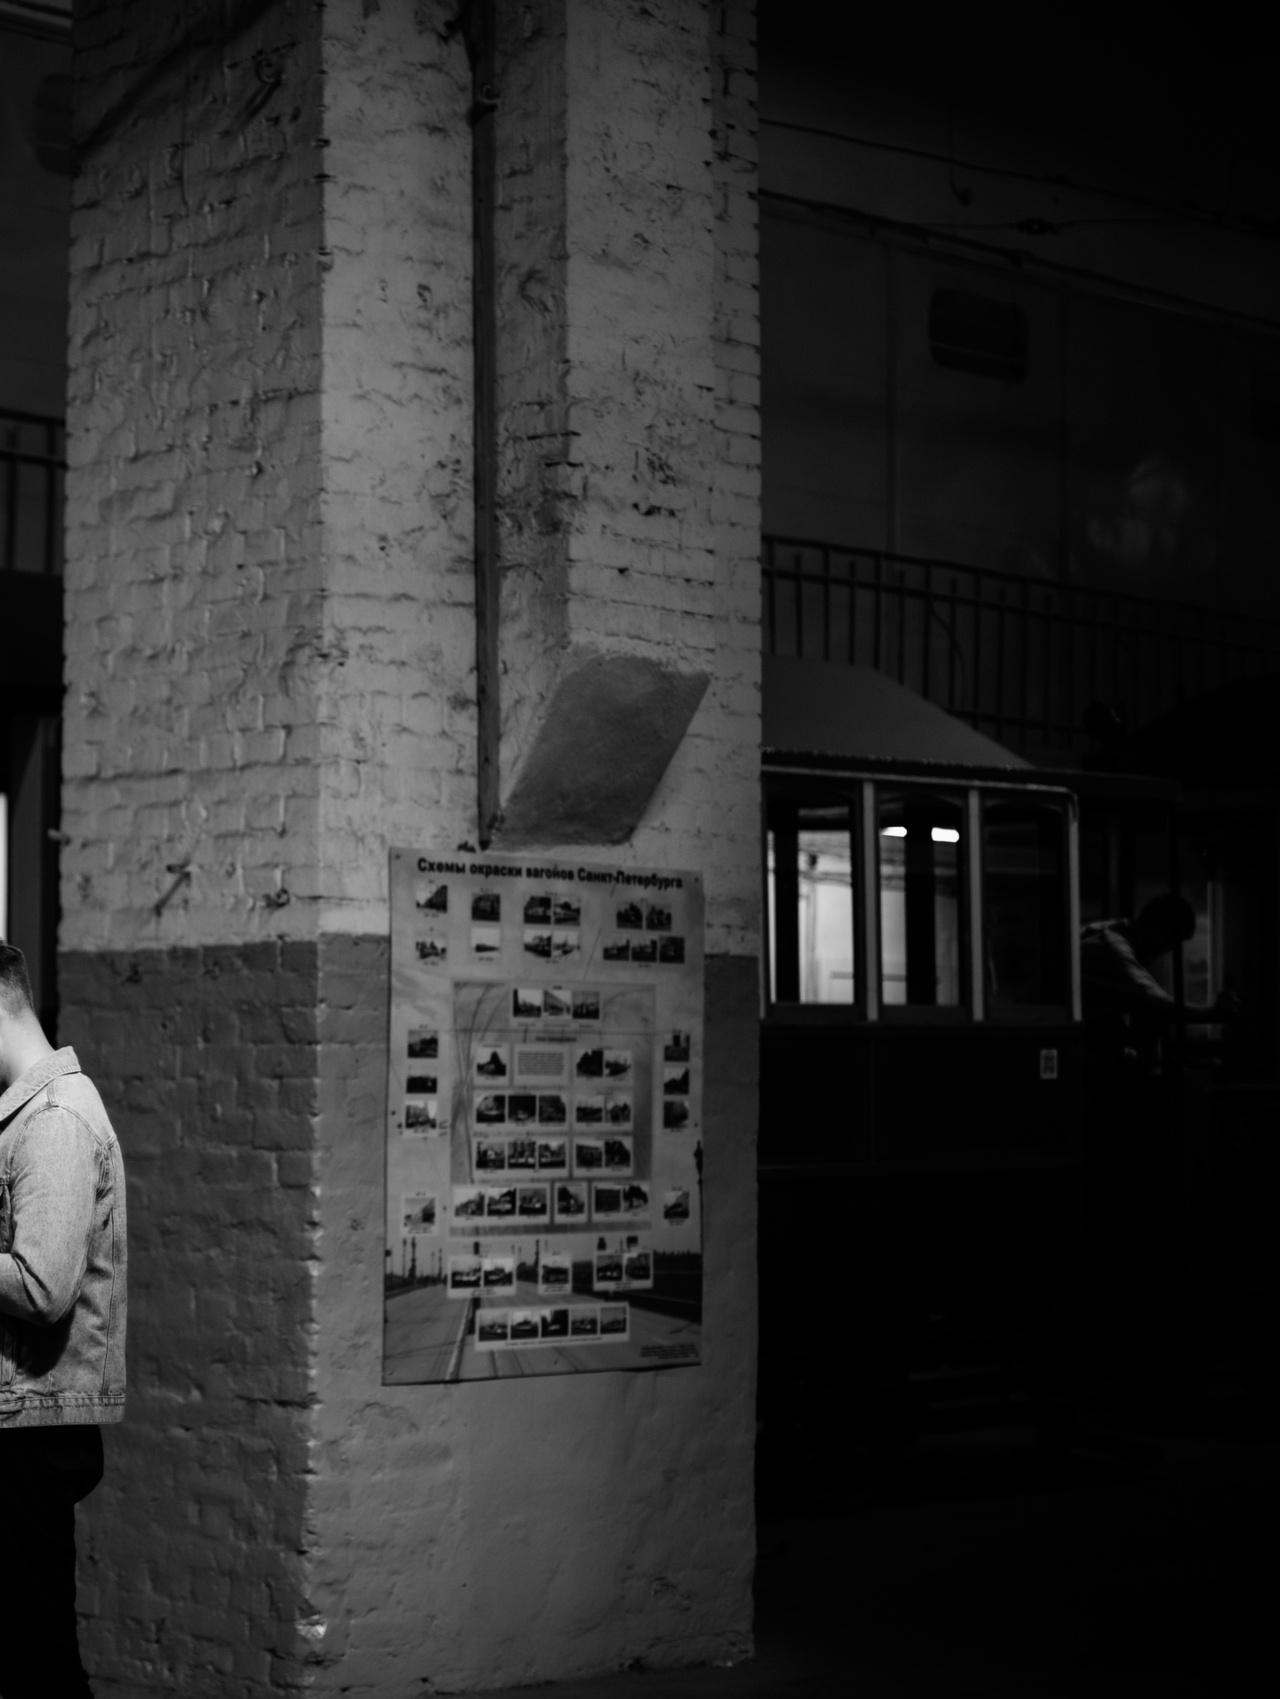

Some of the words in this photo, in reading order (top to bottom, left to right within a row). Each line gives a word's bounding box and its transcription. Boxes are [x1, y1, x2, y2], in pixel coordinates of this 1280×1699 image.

[417, 857, 466, 874] Схемы
[470, 863, 523, 879] окраски
[577, 867, 683, 891] Санкт-Петербурга
